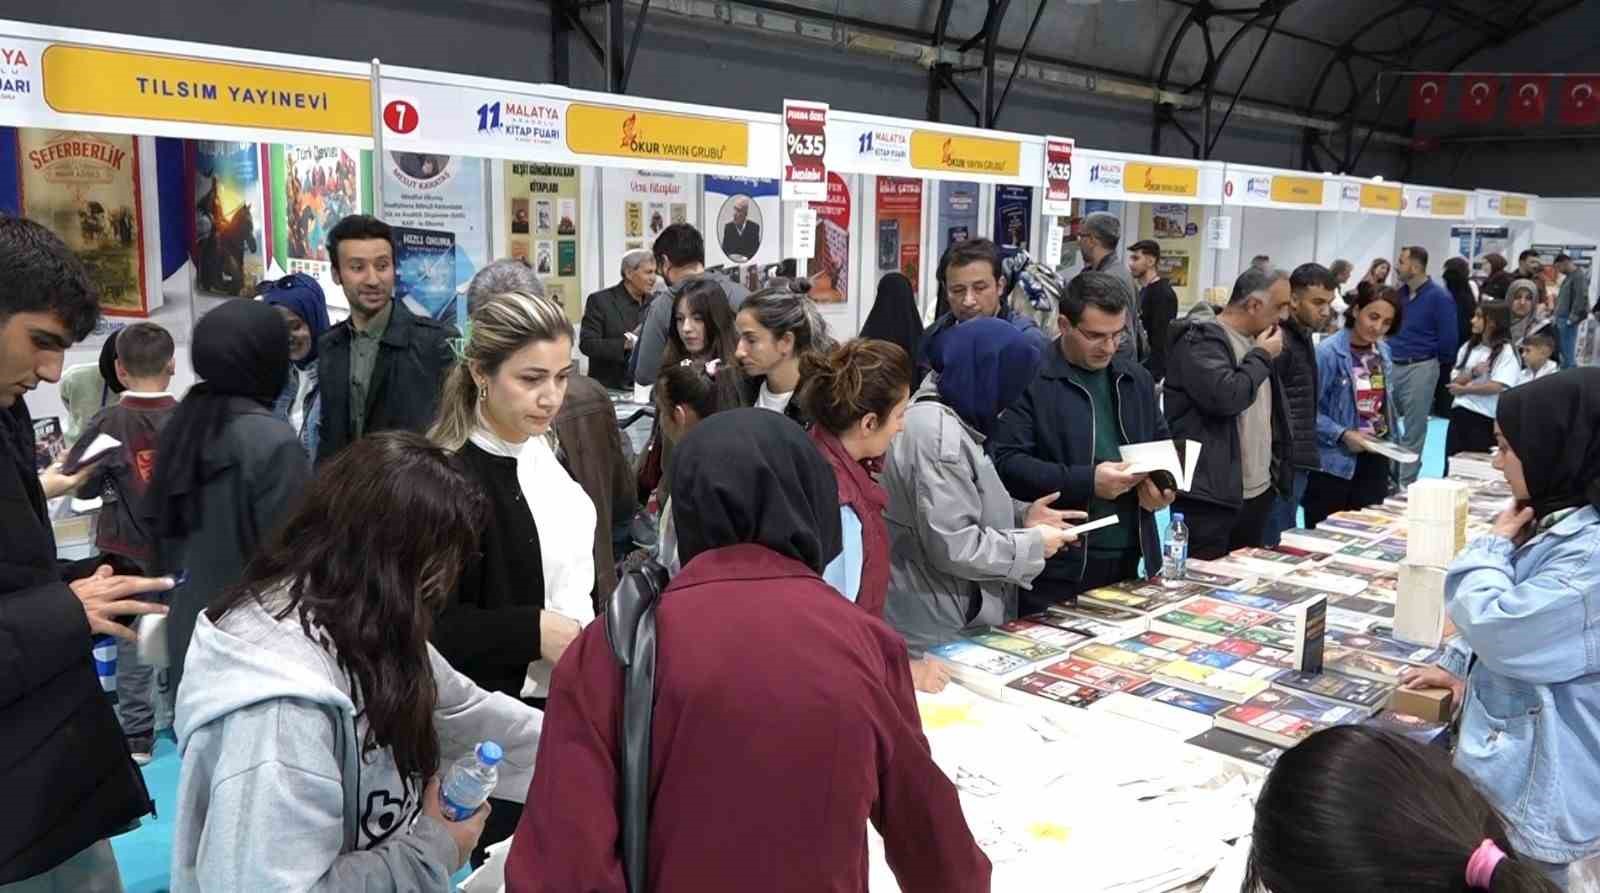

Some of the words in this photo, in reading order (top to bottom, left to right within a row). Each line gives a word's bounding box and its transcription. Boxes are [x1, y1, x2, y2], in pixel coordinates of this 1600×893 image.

[136, 77, 217, 100] TILSIM
[228, 86, 328, 111] YAYINEVİ
[396, 104, 406, 131] 7
[505, 103, 559, 120] MALATYA
[505, 125, 532, 137] KİTAP
[533, 127, 560, 140] FUARI
[29, 141, 126, 170] SEFERBERLİK
[661, 143, 689, 157] YAYIN
[690, 145, 724, 160] GRUBU
[788, 133, 824, 156] %35
